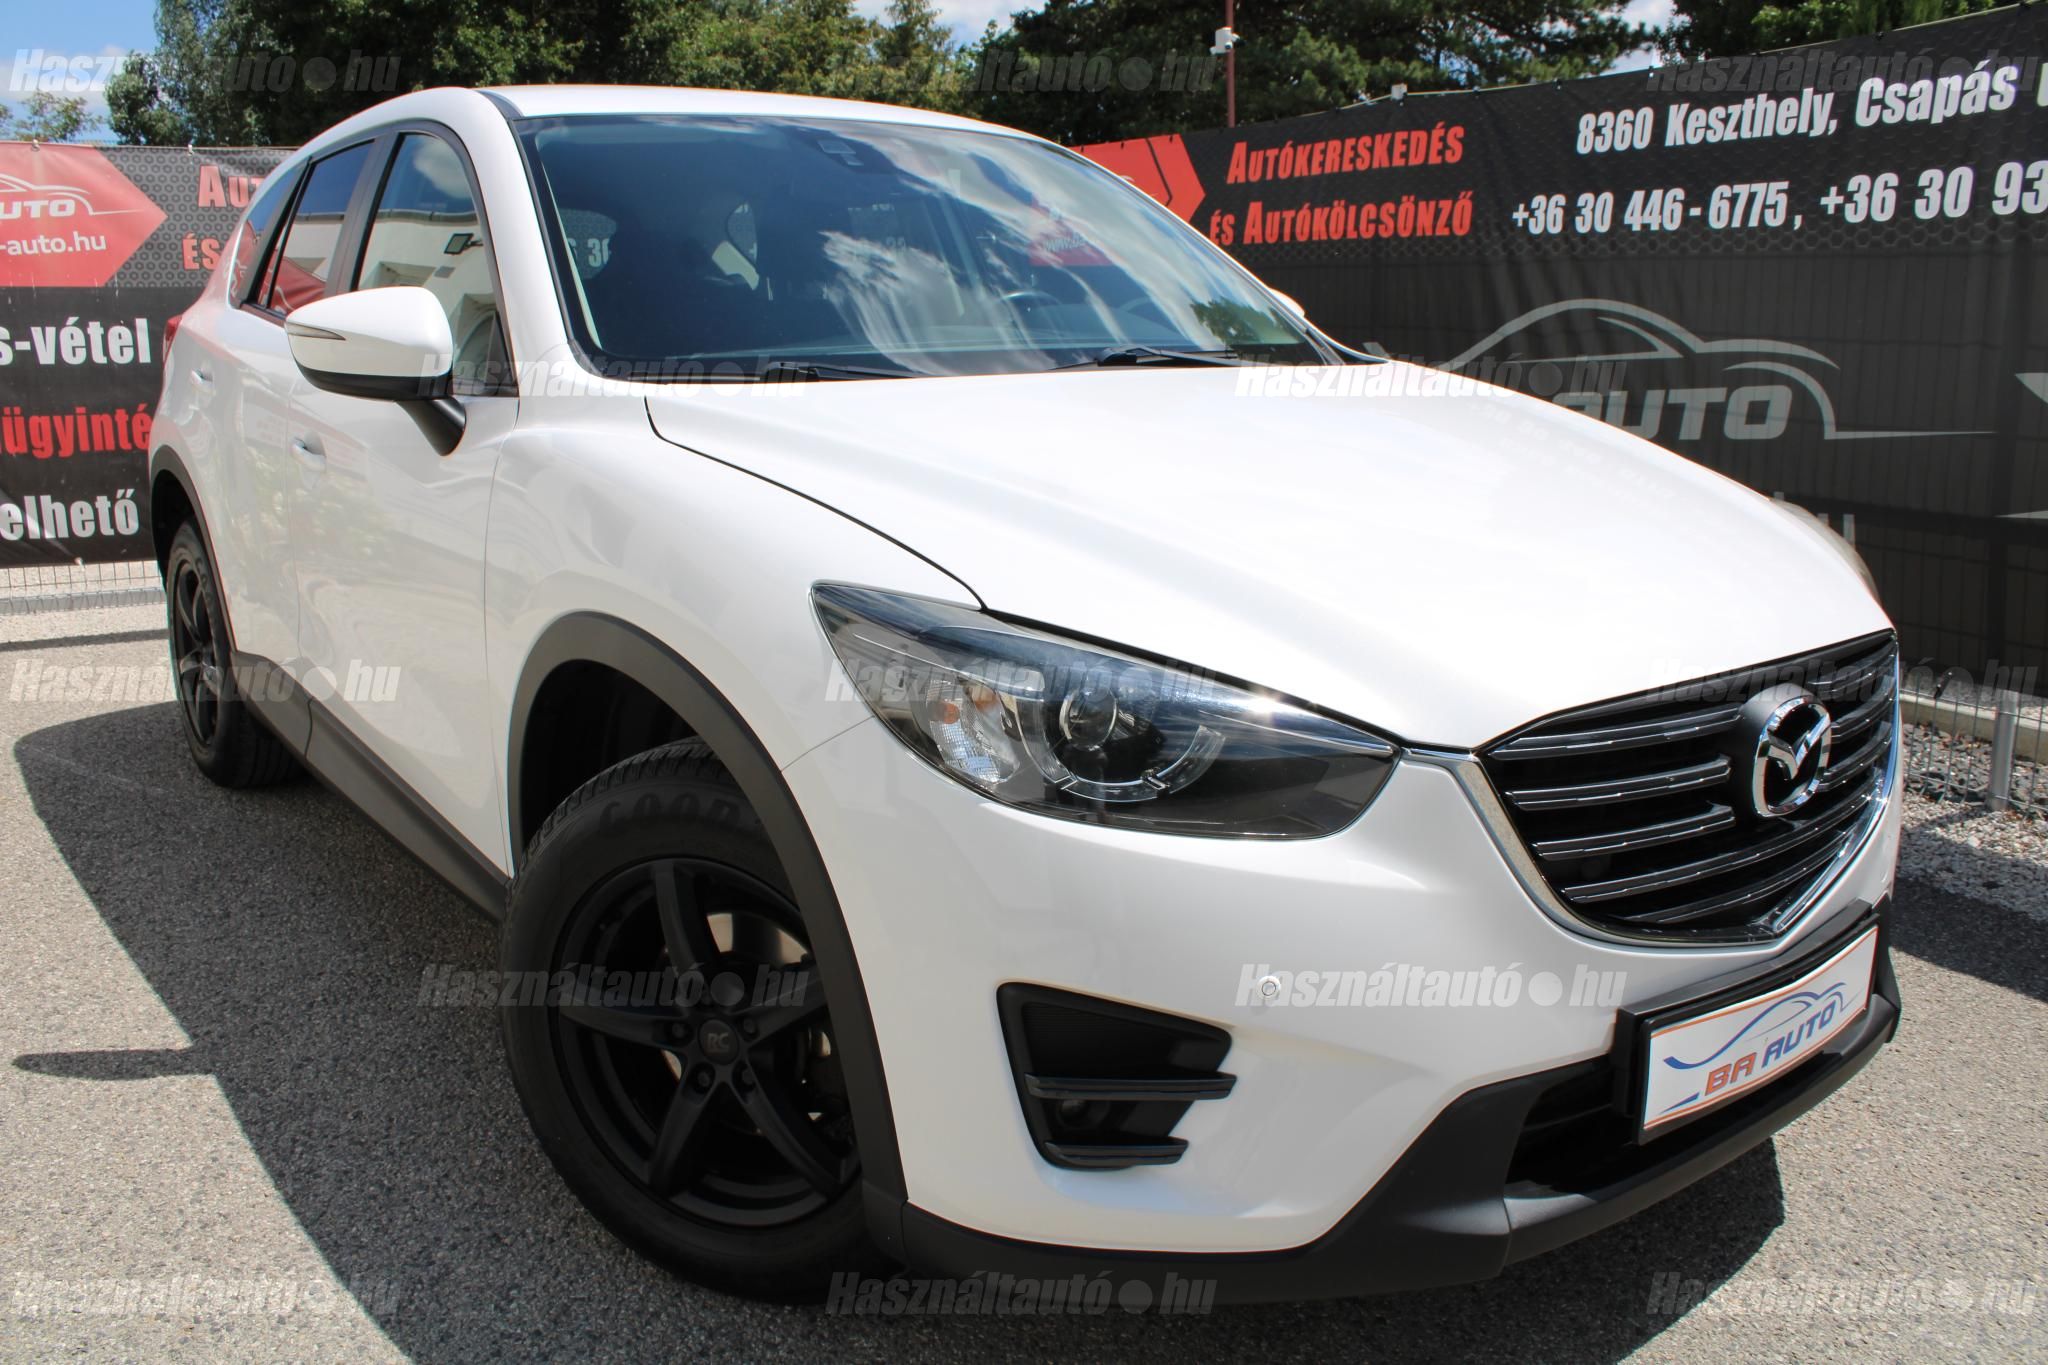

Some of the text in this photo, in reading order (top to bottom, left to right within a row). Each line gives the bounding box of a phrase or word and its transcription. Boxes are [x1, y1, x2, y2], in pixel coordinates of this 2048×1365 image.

[1575, 106, 1654, 154] 8360
[1664, 88, 1838, 147] Keszthely,
[1855, 59, 2018, 127] Csapás
[1512, 194, 1567, 235] +36
[1575, 191, 1614, 233] 30
[1820, 173, 1899, 224] +36
[1914, 168, 1974, 220] 30
[1992, 160, 2048, 216] 93
[1704, 1000, 1837, 1096] BA AUTO
